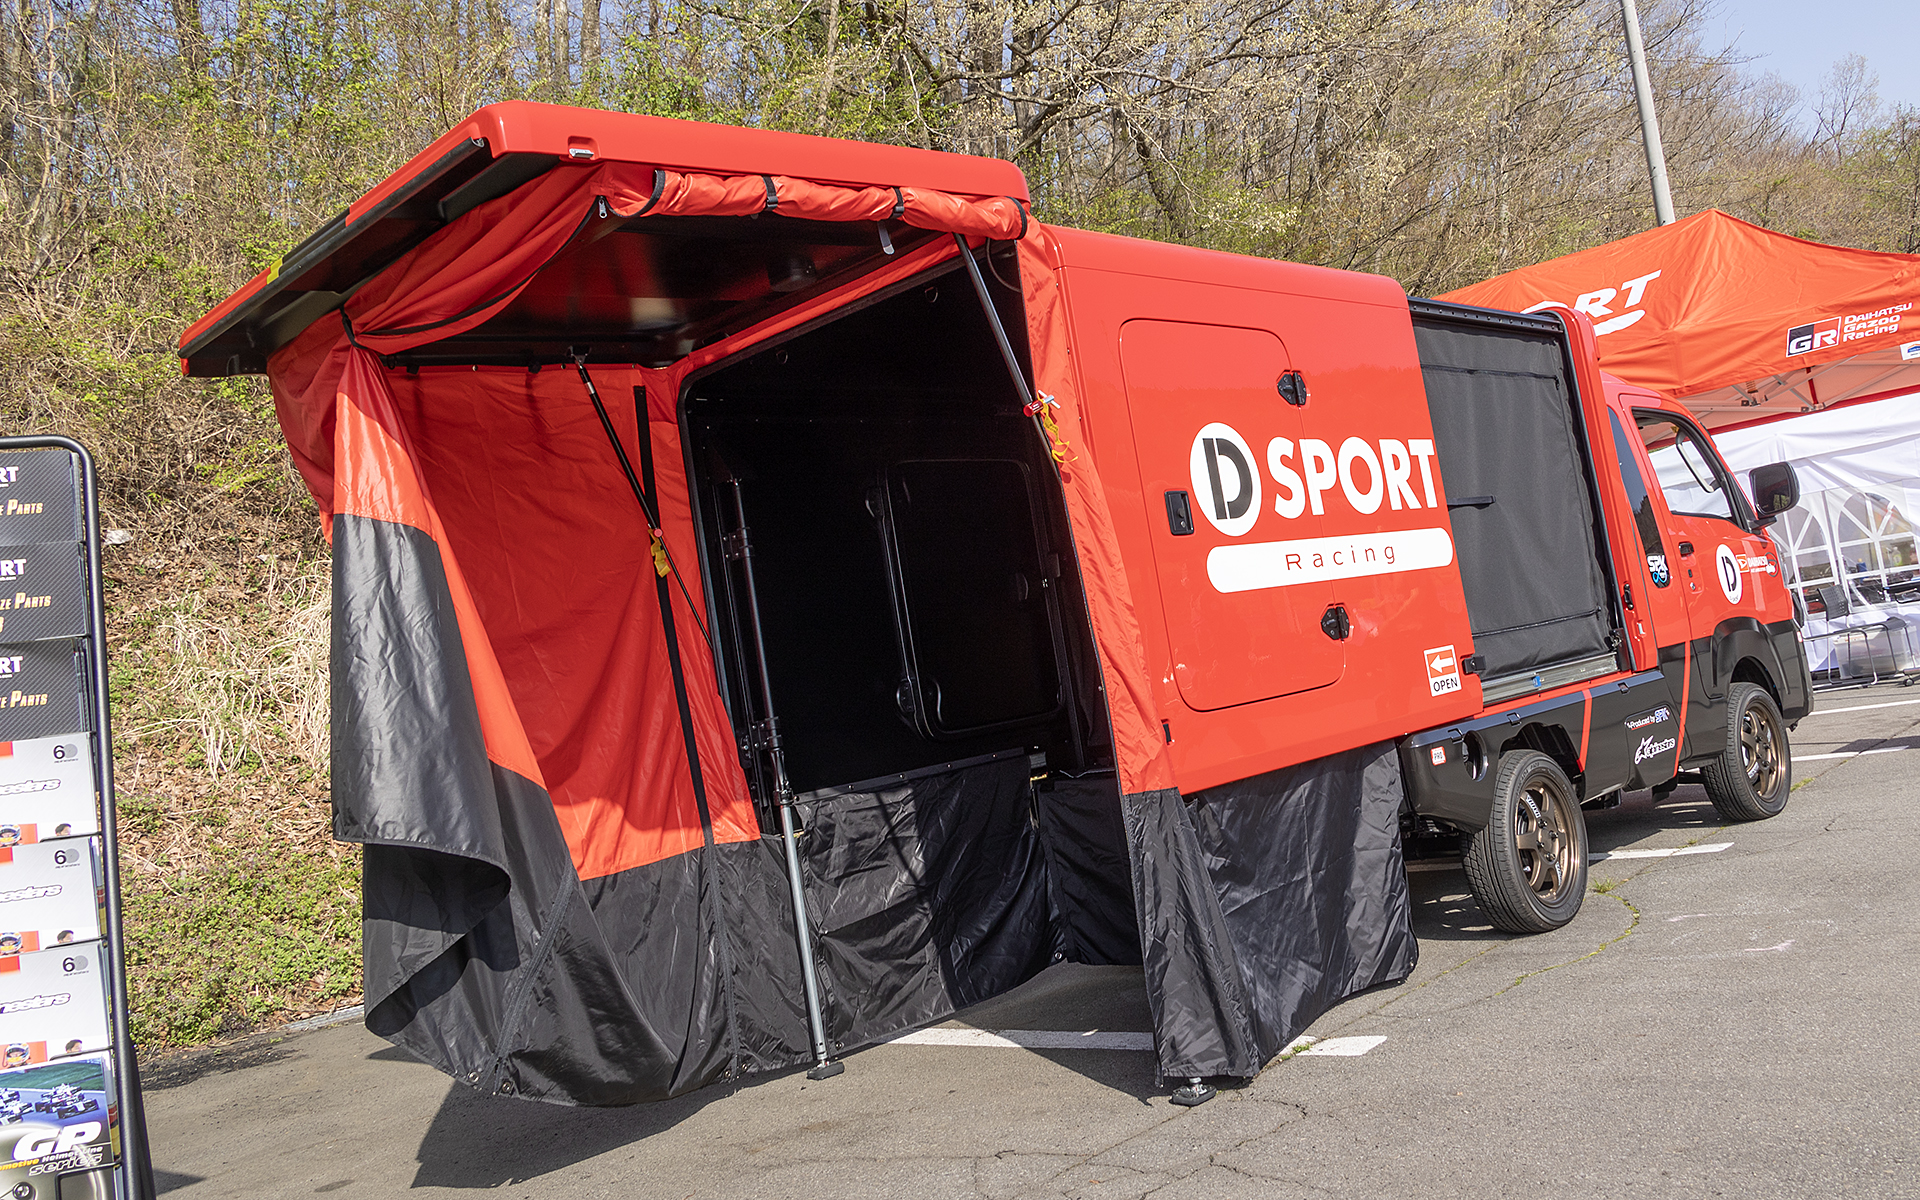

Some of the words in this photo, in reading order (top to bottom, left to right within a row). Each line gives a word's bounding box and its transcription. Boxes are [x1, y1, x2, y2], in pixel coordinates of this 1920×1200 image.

[1843, 315, 1901, 333] GAZOO
[1844, 302, 1913, 324] DAIHATSU
[1789, 329, 1838, 354] GR
[1843, 323, 1899, 342] Racing
[1201, 436, 1254, 520] D
[1266, 436, 1438, 519] SPORT
[1285, 545, 1396, 571] Racing
[1433, 677, 1458, 692] OPEN
[13, 1121, 101, 1161] GP
[0, 1159, 40, 1172] motive
